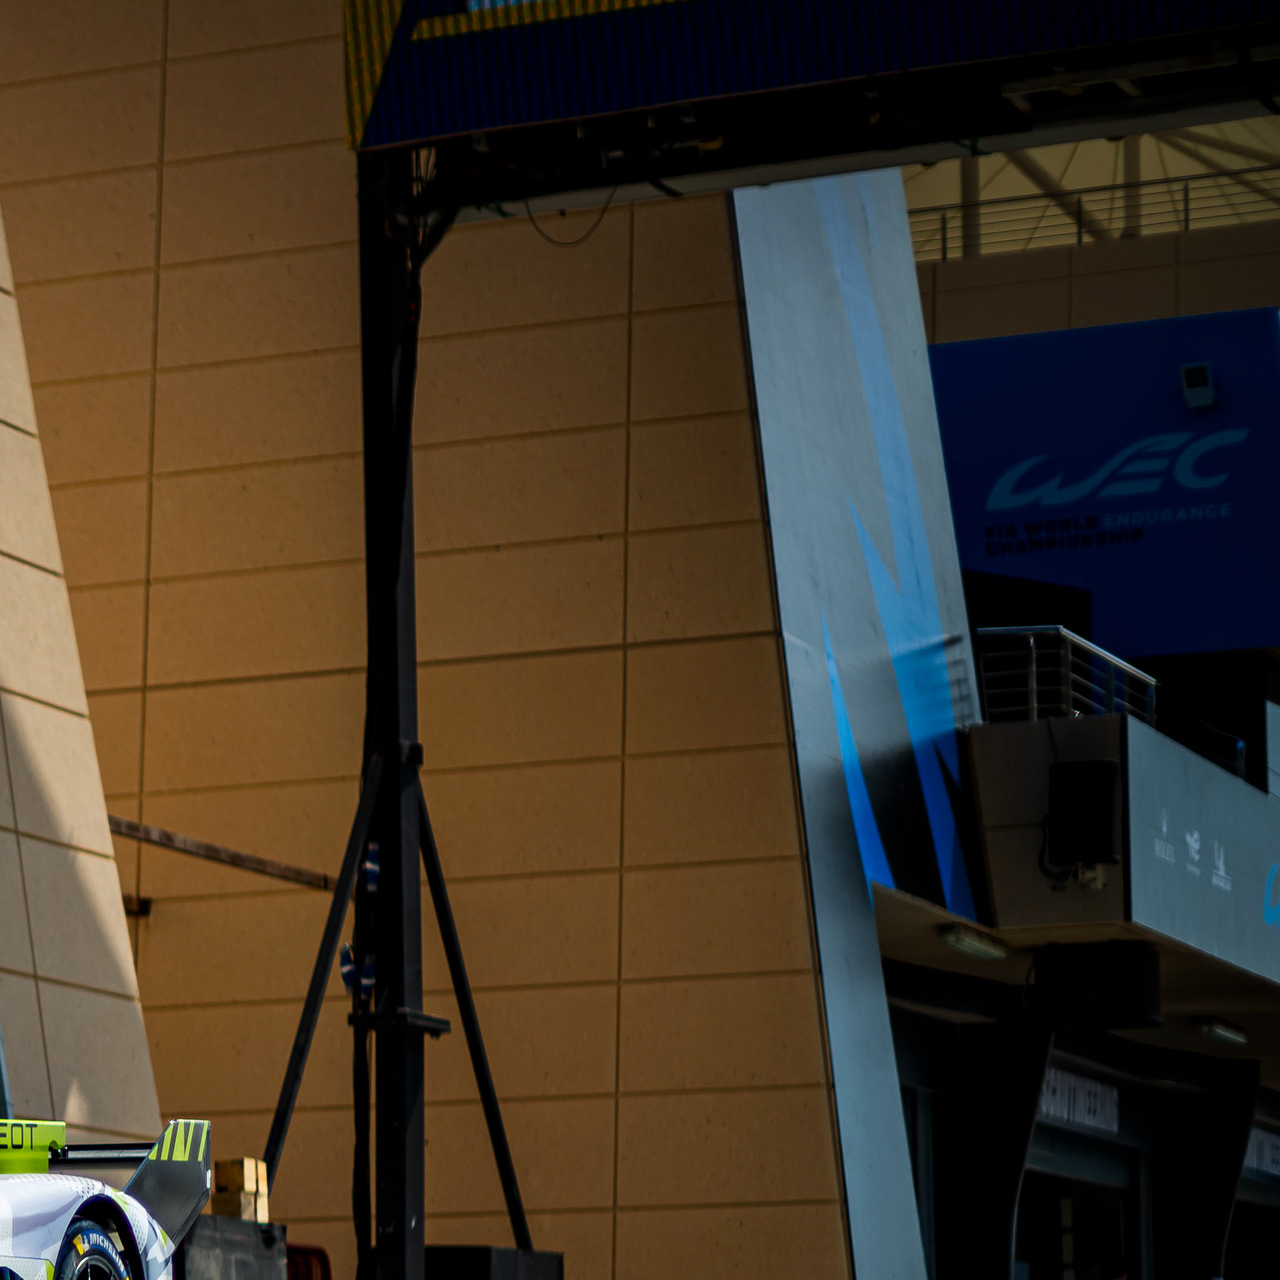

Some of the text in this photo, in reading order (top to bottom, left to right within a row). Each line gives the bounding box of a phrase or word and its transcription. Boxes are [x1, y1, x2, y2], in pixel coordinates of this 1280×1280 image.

[986, 427, 1251, 513] WEC
[985, 502, 1233, 540] FIA WORLD ENDURANCE
[985, 527, 1144, 558] CHAMPIONSHIP
[89, 1233, 125, 1271] MICHELIN
